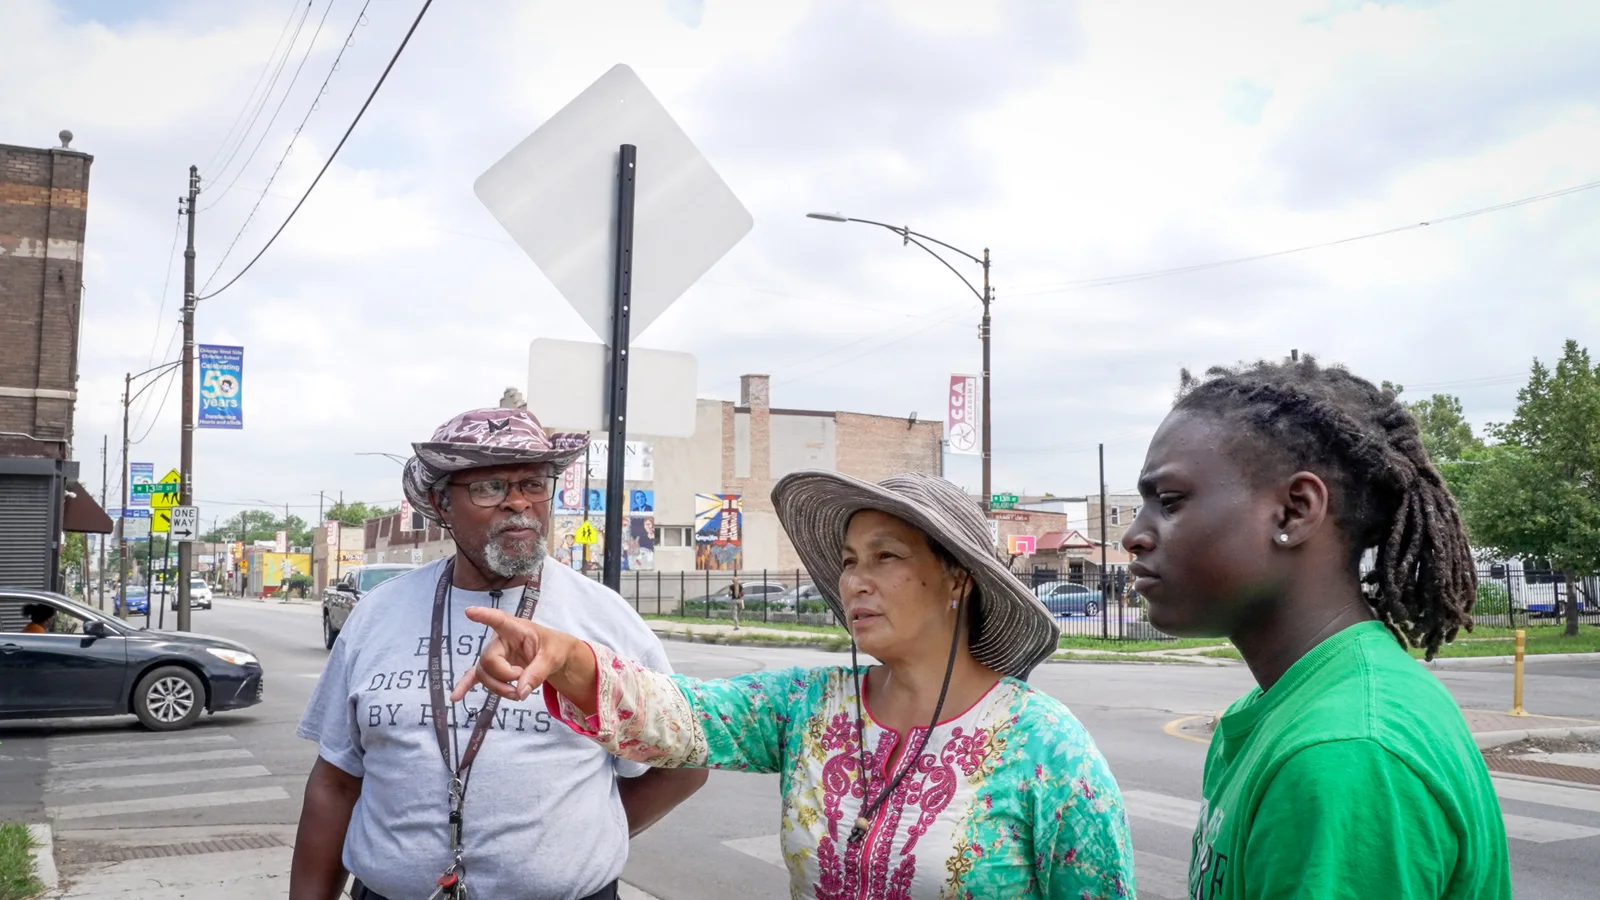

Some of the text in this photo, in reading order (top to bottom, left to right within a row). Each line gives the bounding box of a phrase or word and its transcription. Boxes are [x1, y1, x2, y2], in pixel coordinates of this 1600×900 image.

[201, 362, 240, 372] Celebrating
[201, 370, 239, 398] 50
[203, 398, 238, 409] years
[951, 382, 965, 420] CCA
[174, 509, 195, 518] ONE
[173, 519, 195, 527] WAY
[431, 657, 441, 690] MEMBER
[368, 703, 403, 727] BY
